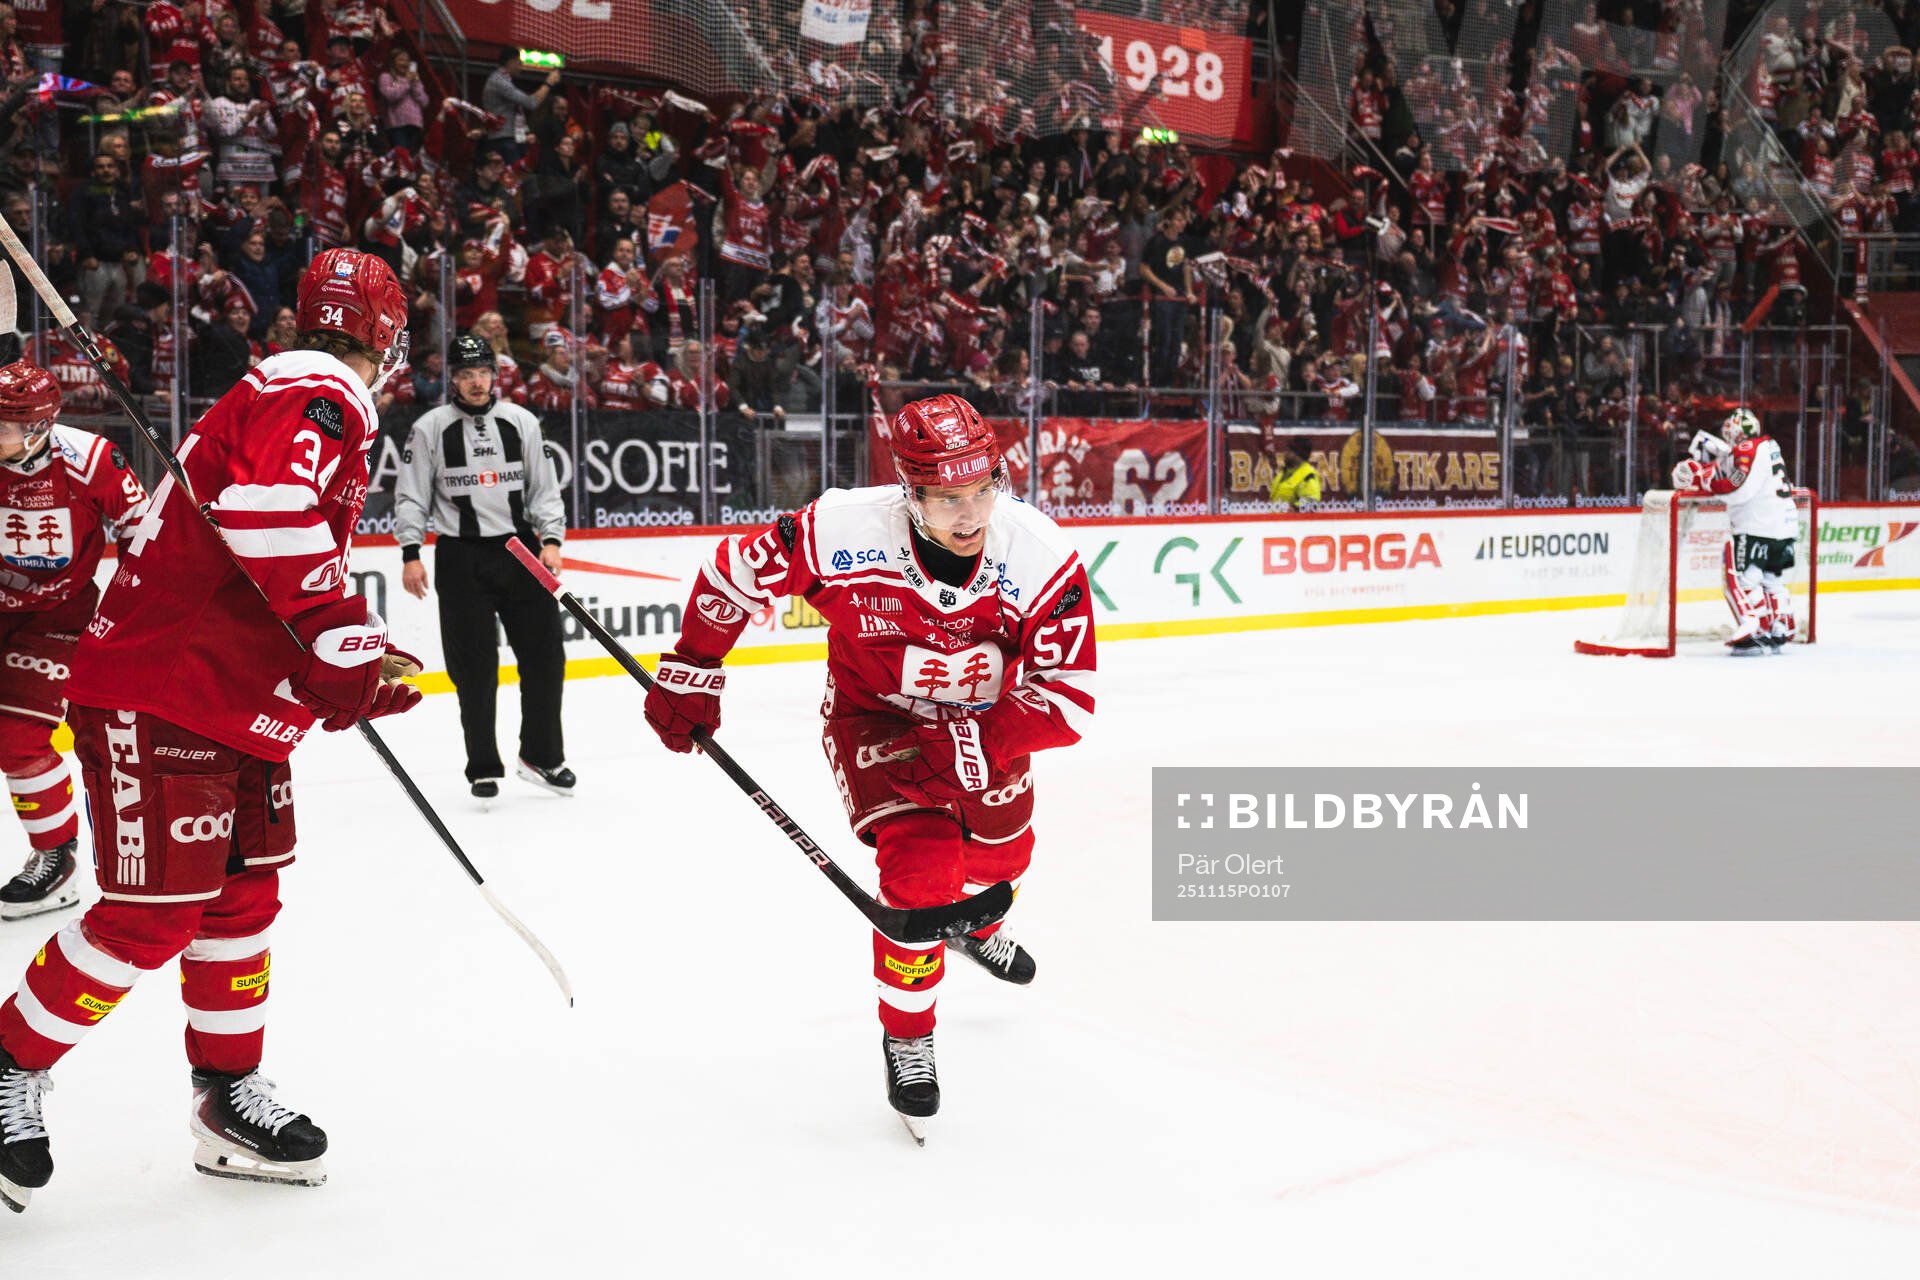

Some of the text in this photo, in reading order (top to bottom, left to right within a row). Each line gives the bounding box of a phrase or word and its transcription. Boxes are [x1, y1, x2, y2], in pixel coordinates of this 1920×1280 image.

[1098, 36, 1225, 101] 1928
[319, 305, 343, 327] 34
[473, 447, 498, 457] SHL
[585, 439, 732, 494] SOFIE
[956, 456, 989, 476] LILIUM
[445, 470, 524, 488] TRYGG HANS
[856, 549, 887, 564] SCA
[1262, 533, 1443, 575] BORGA
[1500, 533, 1609, 559] EUROCON
[16, 559, 57, 569] TIMRÅ IK
[905, 565, 923, 587] EAB
[971, 574, 987, 595] EAB
[999, 577, 1020, 601] CA
[338, 631, 386, 652] BAU
[880, 630, 908, 638] RENTAL
[1033, 615, 1089, 667] 57
[154, 746, 217, 761] BAUER
[750, 790, 831, 867] BAUER
[888, 959, 938, 975] SUNDFRAKT
[236, 970, 270, 988] SUNDF
[224, 1127, 260, 1150] BAUER
